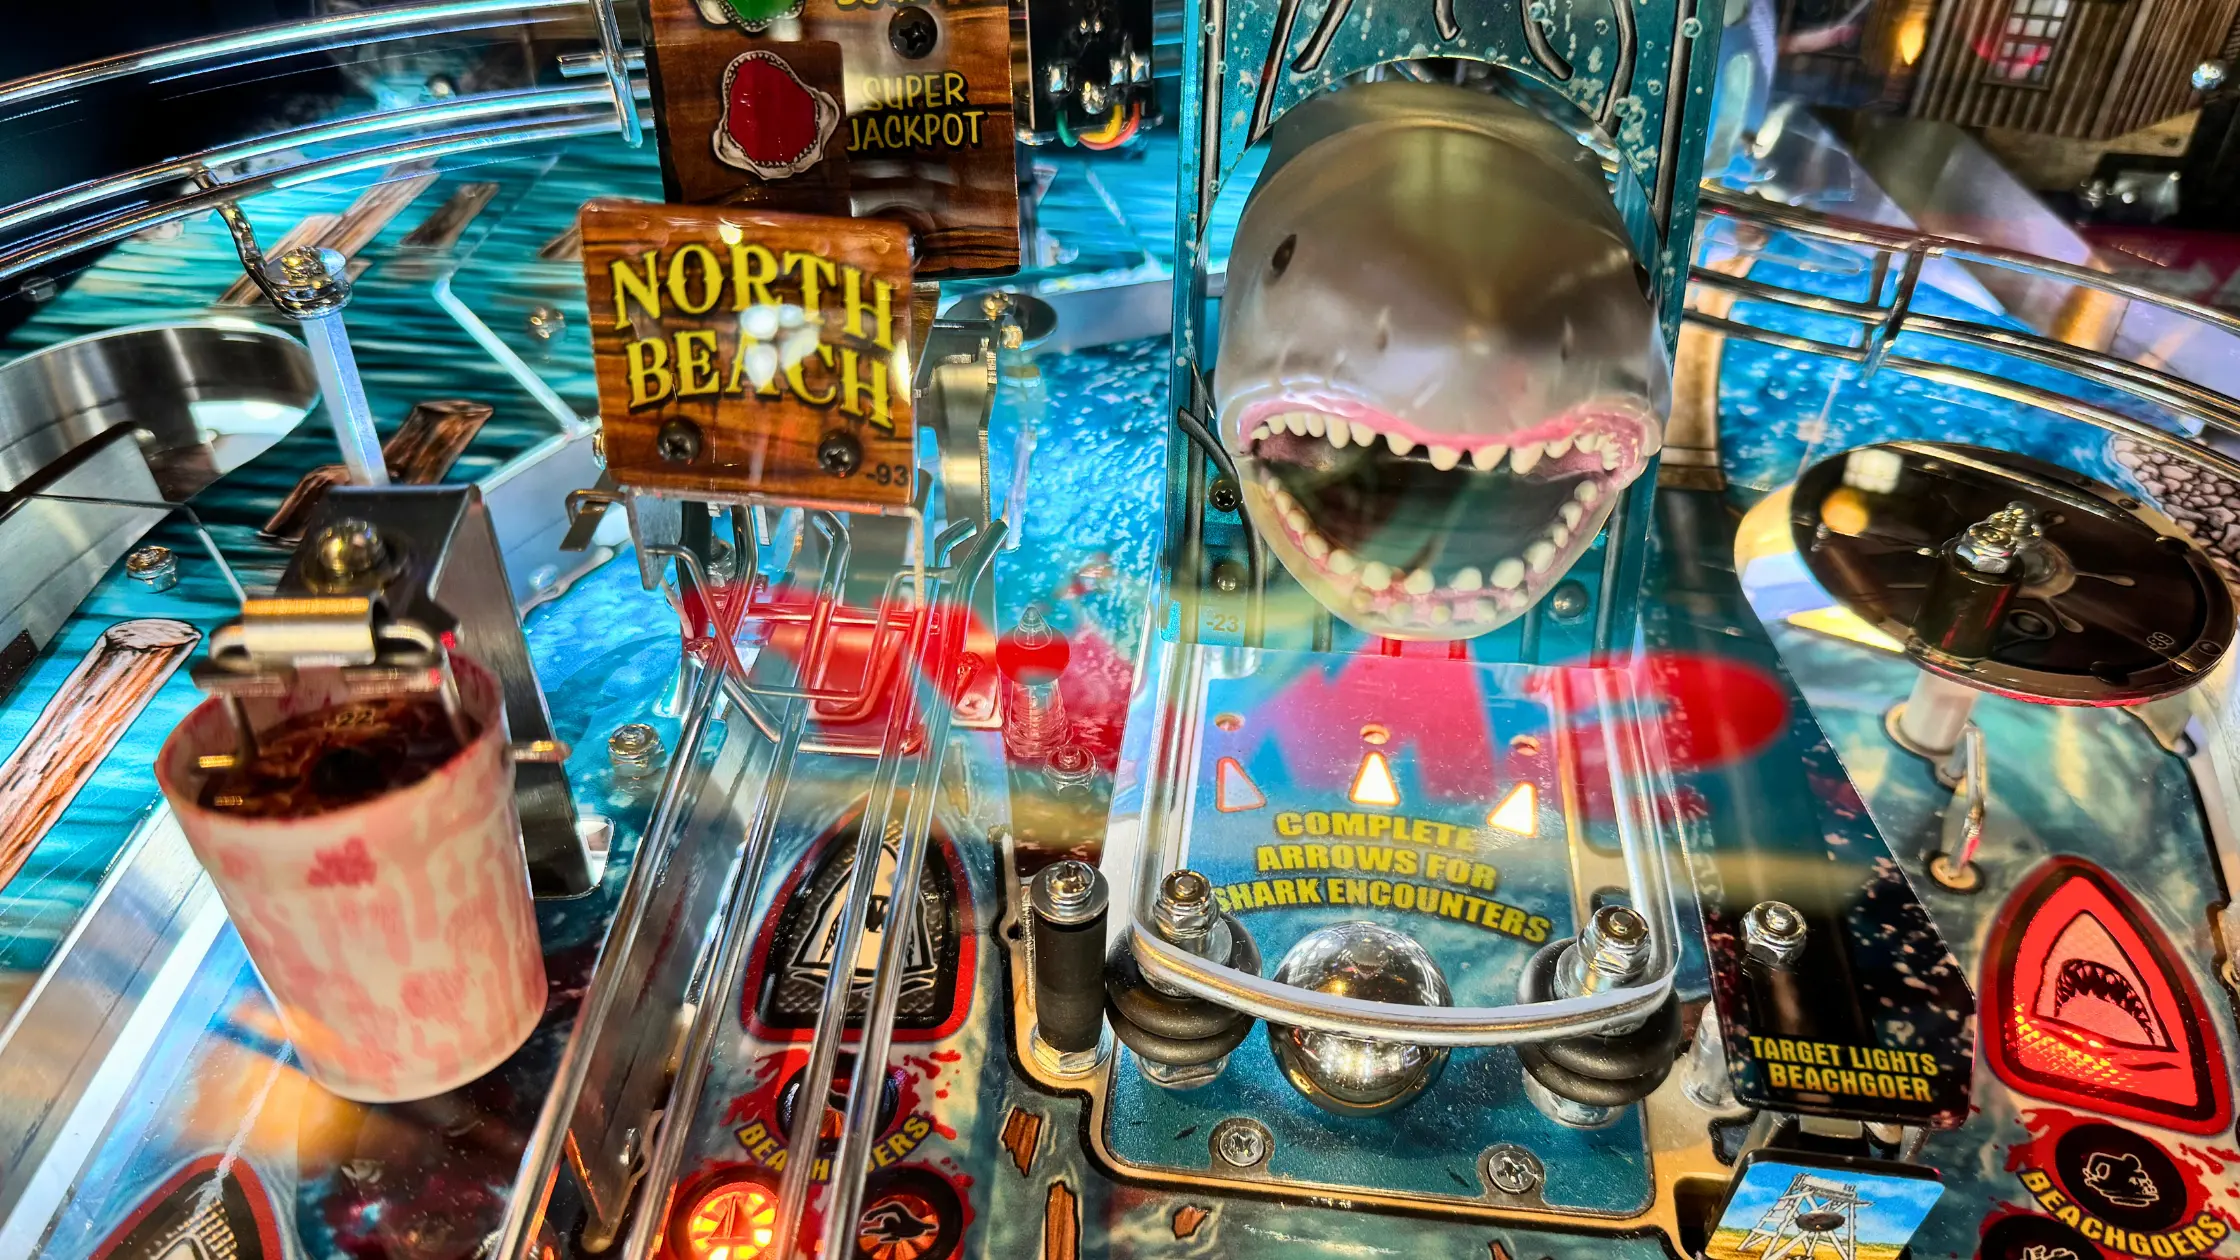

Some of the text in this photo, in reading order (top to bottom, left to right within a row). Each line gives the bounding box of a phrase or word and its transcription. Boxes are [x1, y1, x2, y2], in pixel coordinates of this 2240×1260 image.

[862, 72, 965, 111] SUPER
[847, 111, 985, 151] JACKPOT
[611, 243, 895, 352] NORTH
[626, 330, 894, 429] BEACH
[866, 463, 909, 487] -93
[1206, 613, 1240, 633] -23
[1276, 811, 1476, 852] COMPLETE
[1257, 844, 1497, 890] ARROWS FOR
[1212, 878, 1552, 943] SHARK ENCOUNTERS
[1749, 1036, 1939, 1077] TARGET LIGHTS
[1768, 1062, 1933, 1102] BEACHGOER
[738, 1115, 930, 1181] BEAHERS
[2020, 1170, 2228, 1258] BEACHGOERS
